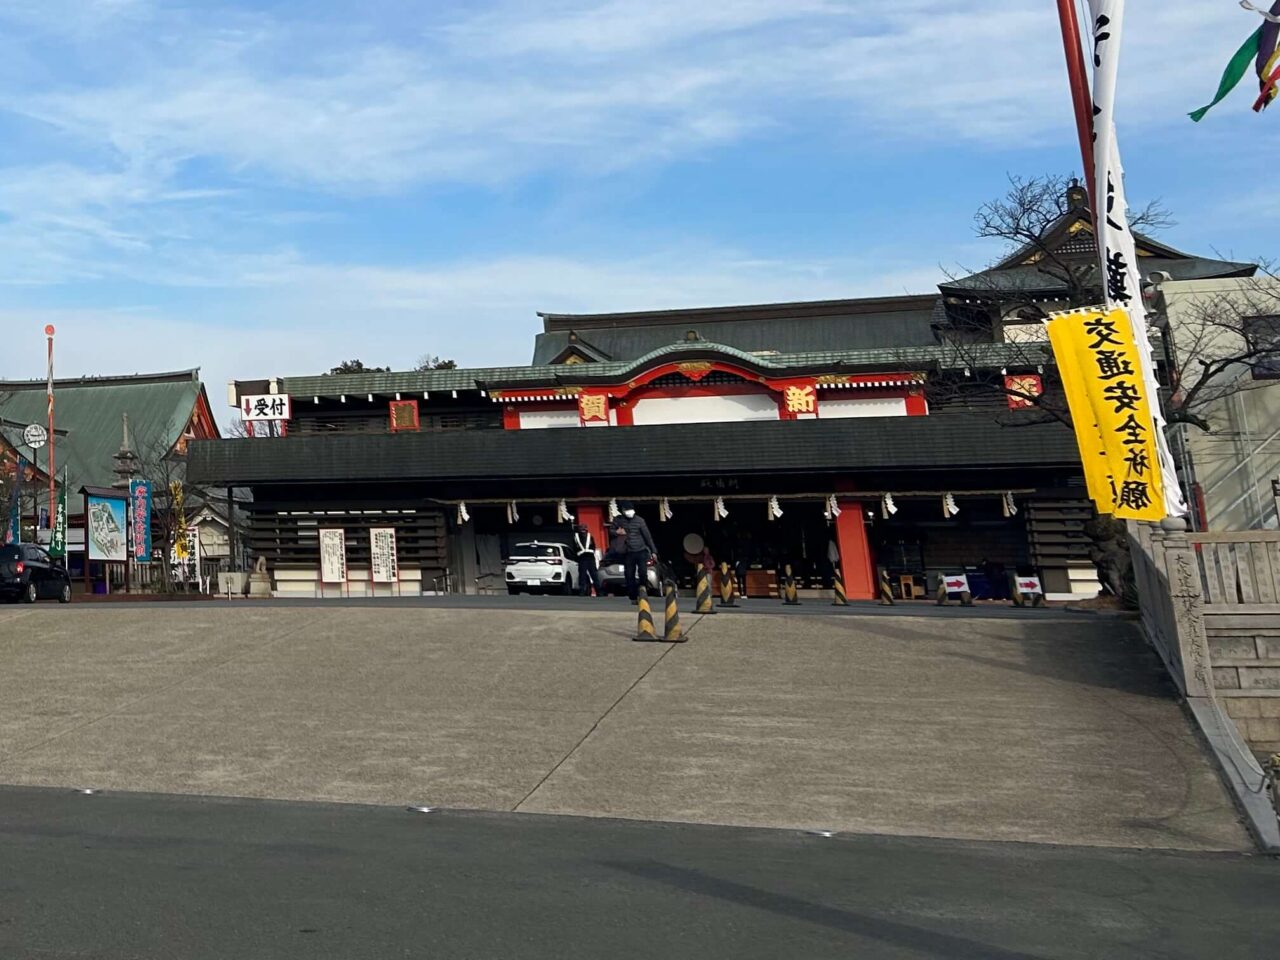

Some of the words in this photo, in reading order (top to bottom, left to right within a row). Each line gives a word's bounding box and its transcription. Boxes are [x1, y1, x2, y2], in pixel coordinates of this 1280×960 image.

[254, 398, 286, 416] 受付
[580, 394, 607, 420] 賀
[786, 385, 815, 412] 新
